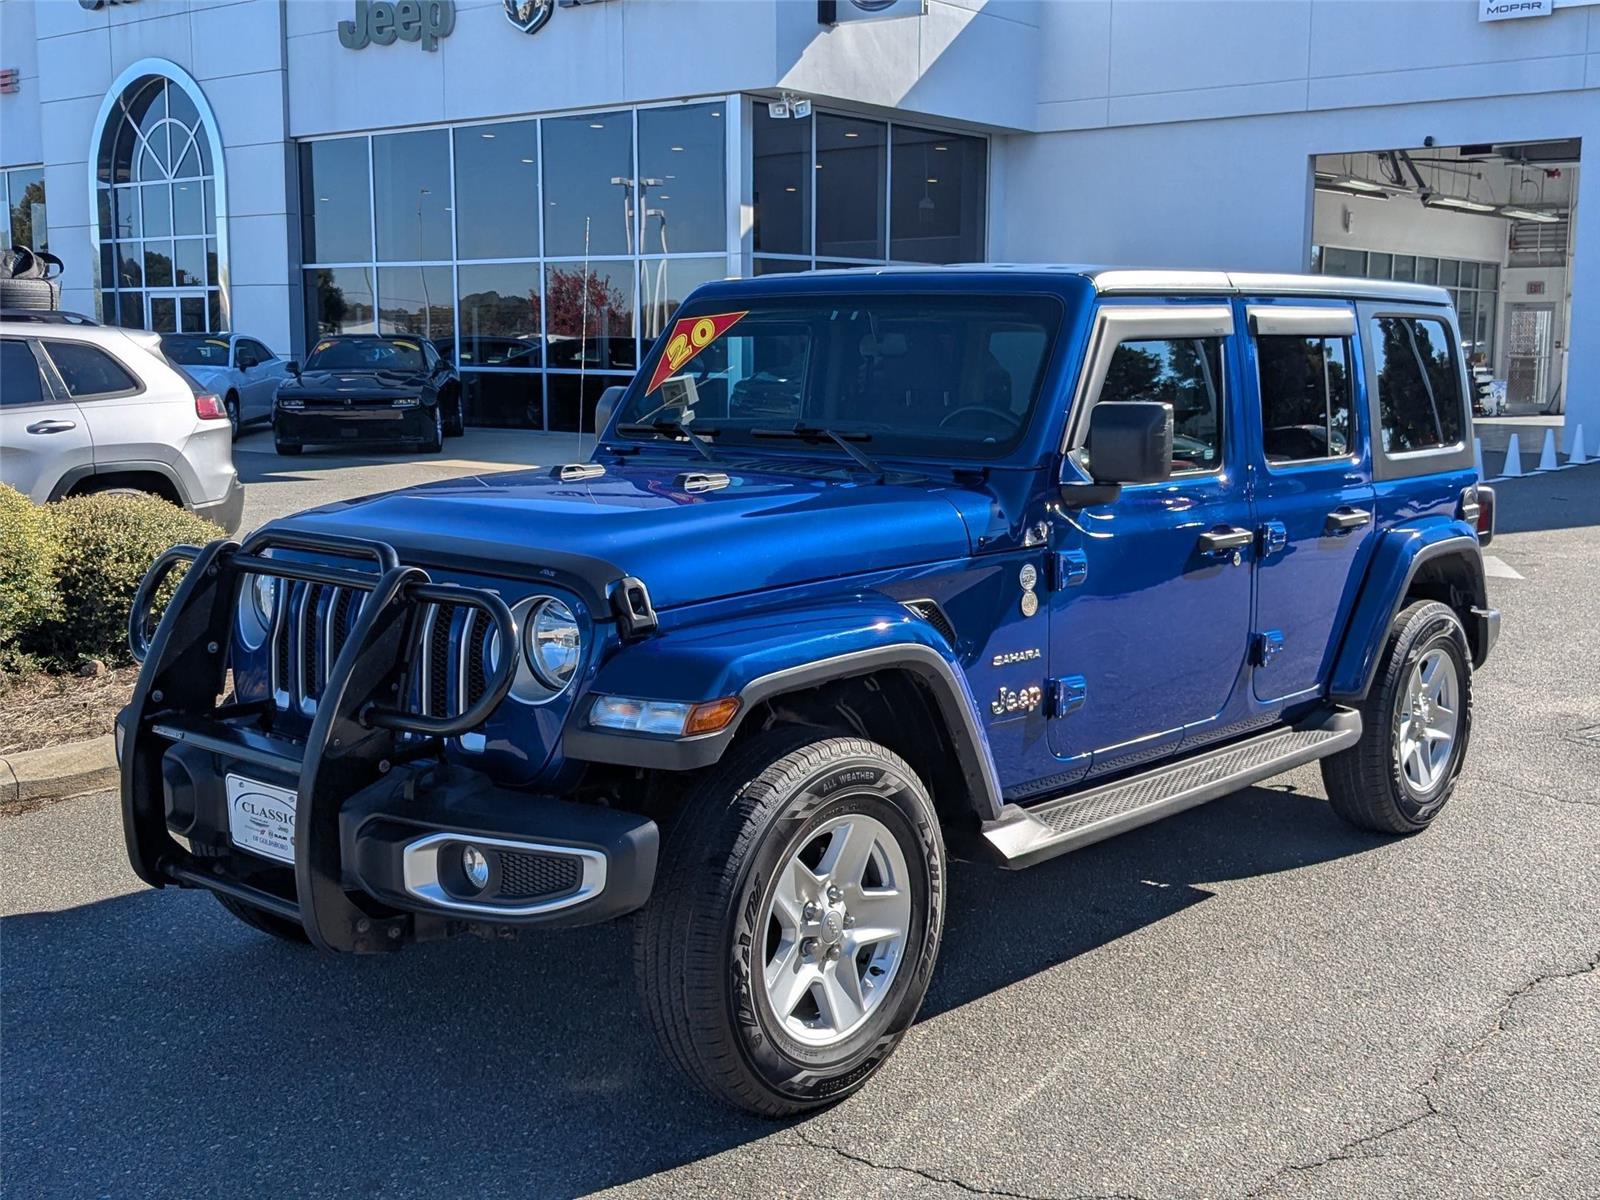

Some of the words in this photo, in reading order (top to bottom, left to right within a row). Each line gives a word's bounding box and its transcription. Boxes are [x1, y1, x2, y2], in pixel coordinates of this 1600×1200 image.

[1486, 1, 1542, 15] MOPAR
[338, 0, 456, 52] Jeep
[666, 318, 716, 370] 20
[993, 648, 1042, 666] SAHARA
[992, 685, 1042, 715] Jeep
[823, 779, 837, 793] ALL
[839, 771, 875, 785] WEATHER
[241, 801, 295, 826] CLASSIC
